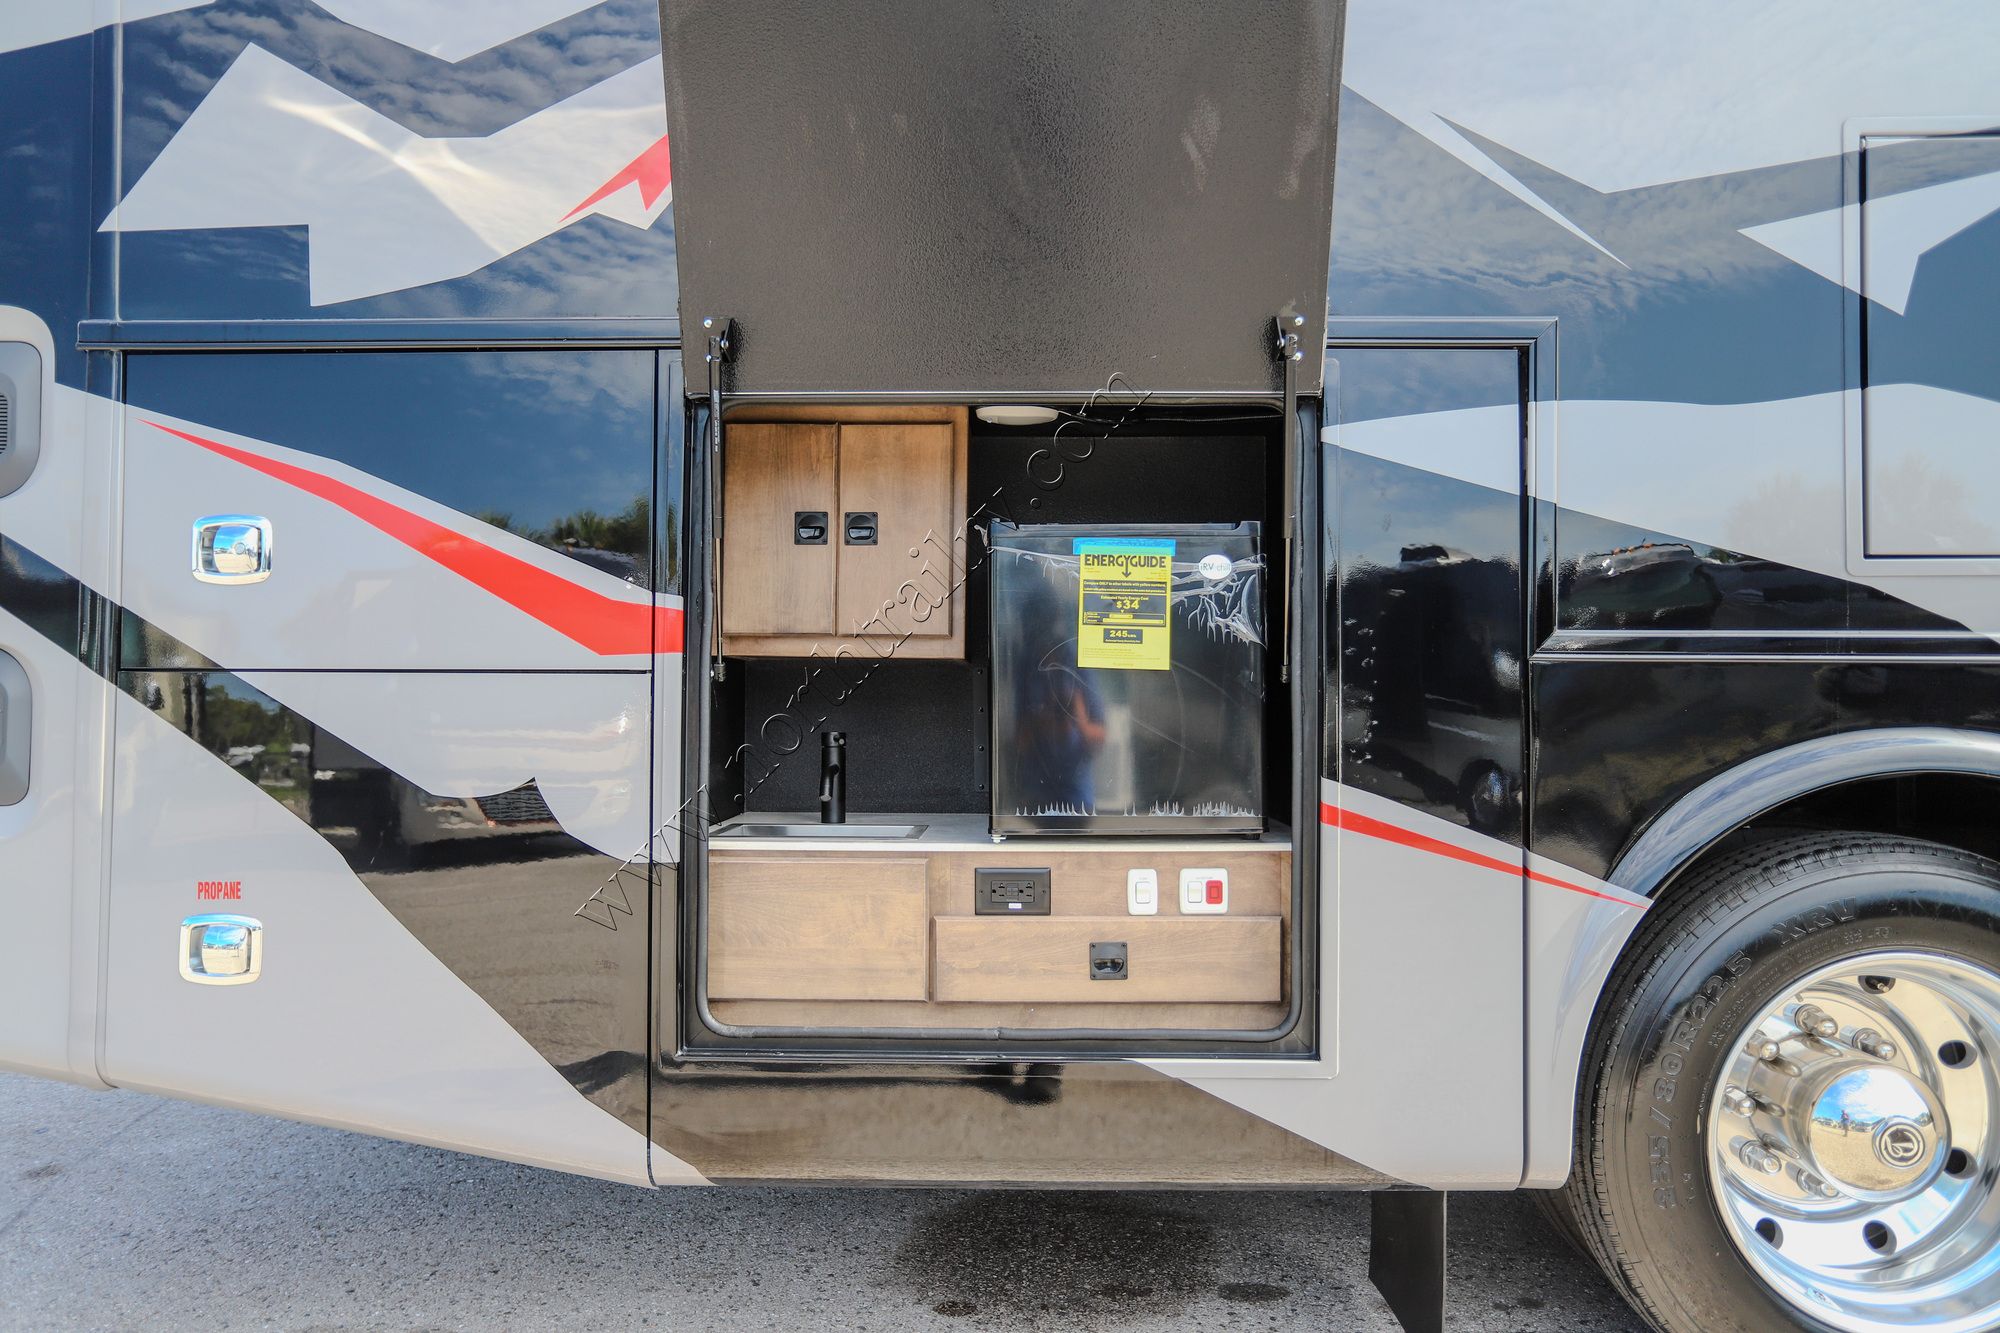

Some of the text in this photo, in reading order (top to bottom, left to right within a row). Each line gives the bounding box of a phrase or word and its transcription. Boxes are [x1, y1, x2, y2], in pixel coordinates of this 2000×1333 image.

[1084, 554, 1166, 569] ENERGYGUIDE
[1116, 600, 1139, 609] $34
[1110, 630, 1128, 638] 245
[197, 881, 241, 899] PROPANE
